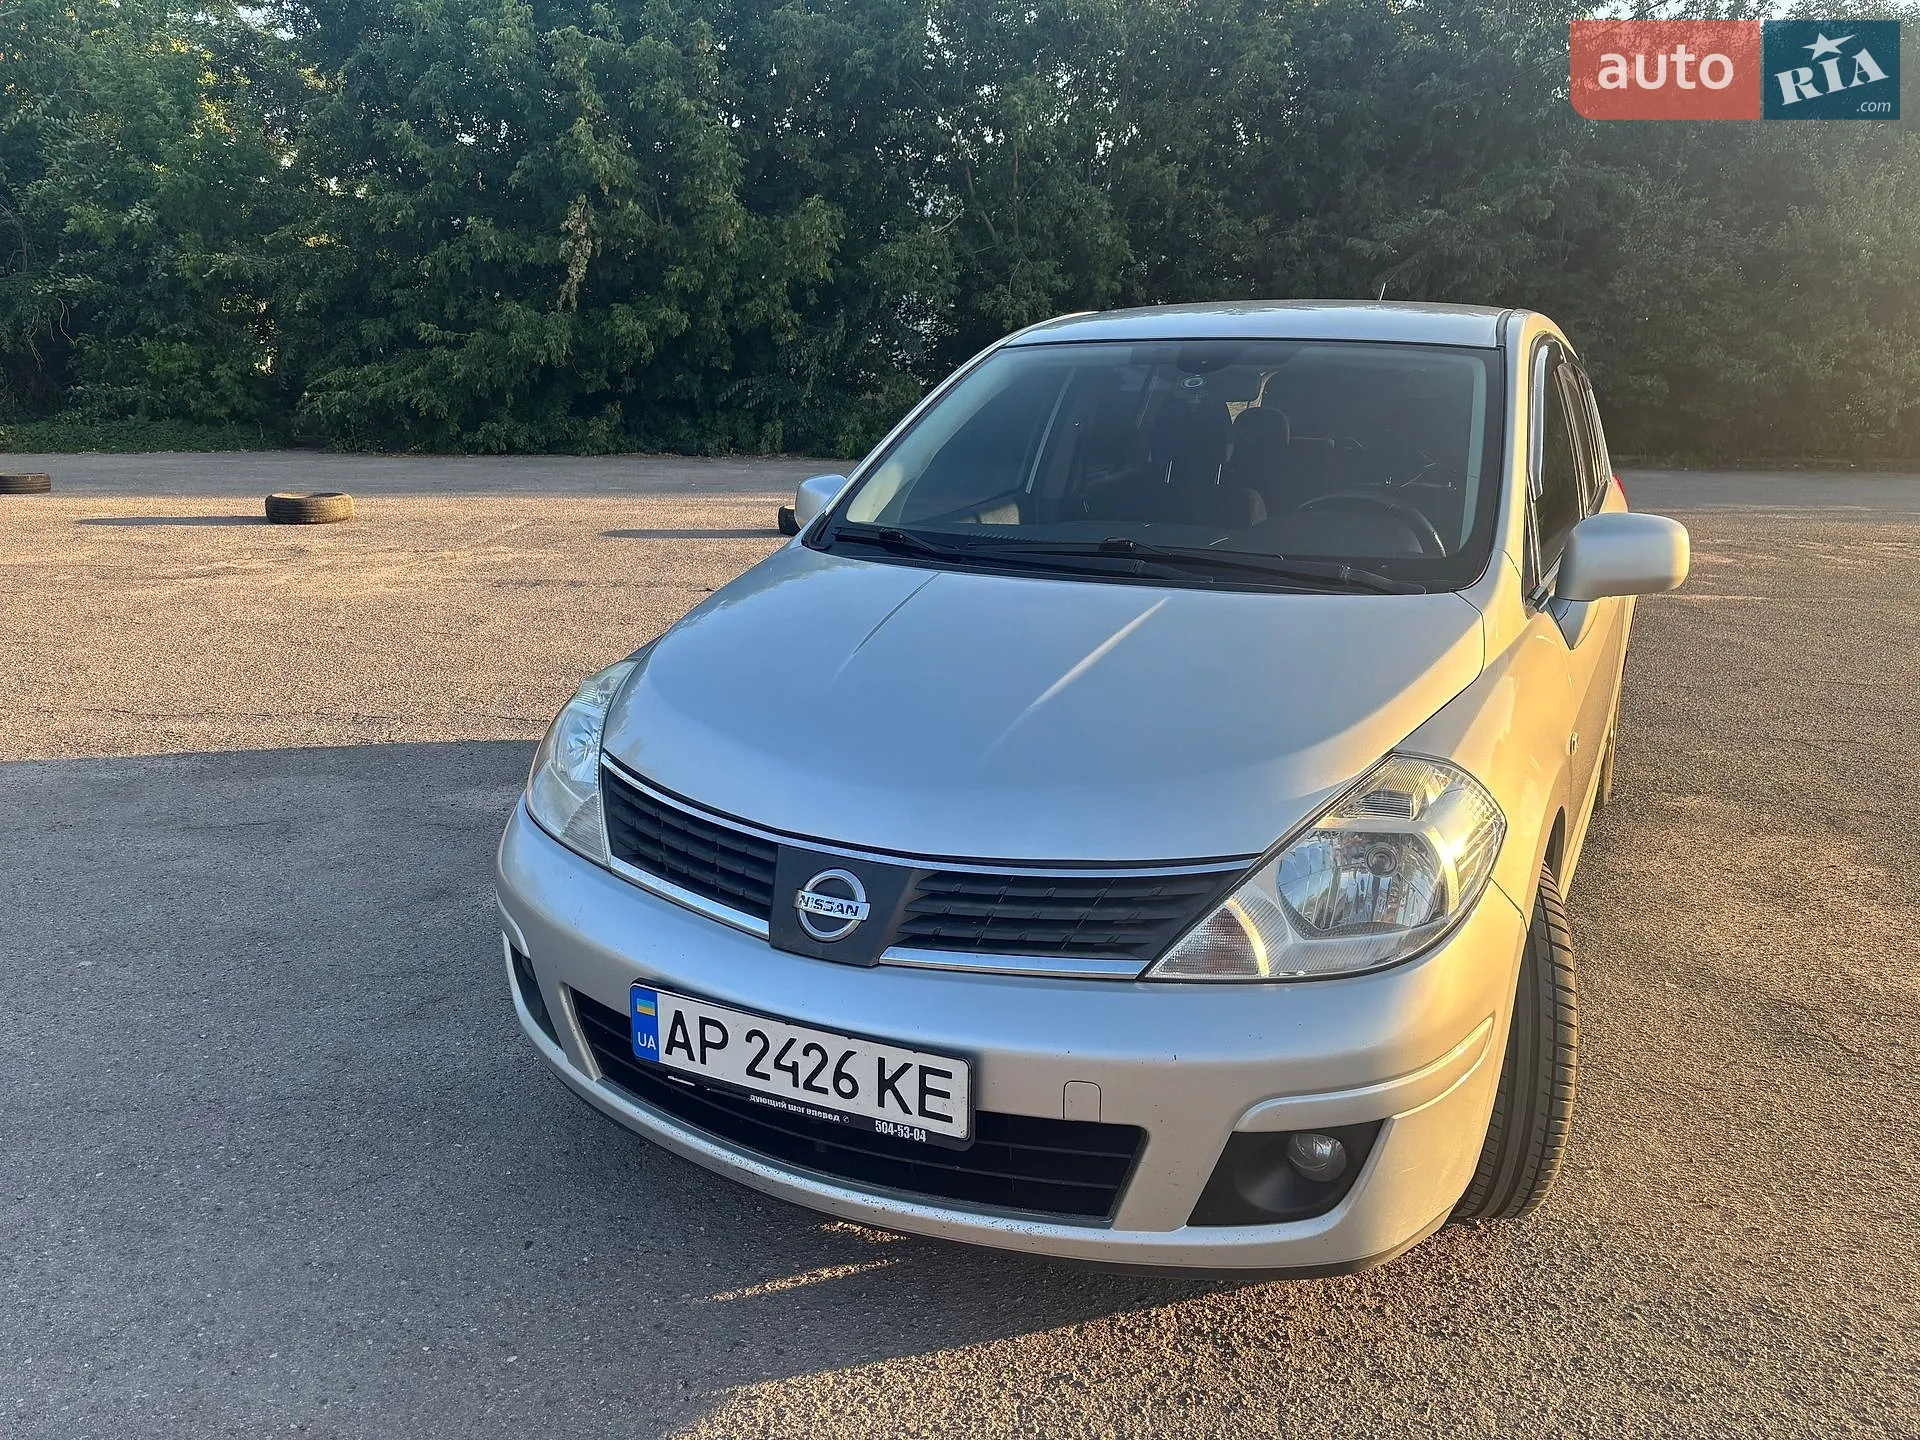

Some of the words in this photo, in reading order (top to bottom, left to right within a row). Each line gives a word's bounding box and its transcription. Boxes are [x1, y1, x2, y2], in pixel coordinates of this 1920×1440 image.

[799, 894, 860, 917] NISSAN
[637, 1031, 657, 1051] UA
[664, 1009, 729, 1065] AP
[745, 1028, 860, 1100] 2426
[877, 1056, 954, 1124] KE
[875, 1119, 927, 1143] 504-53-04
